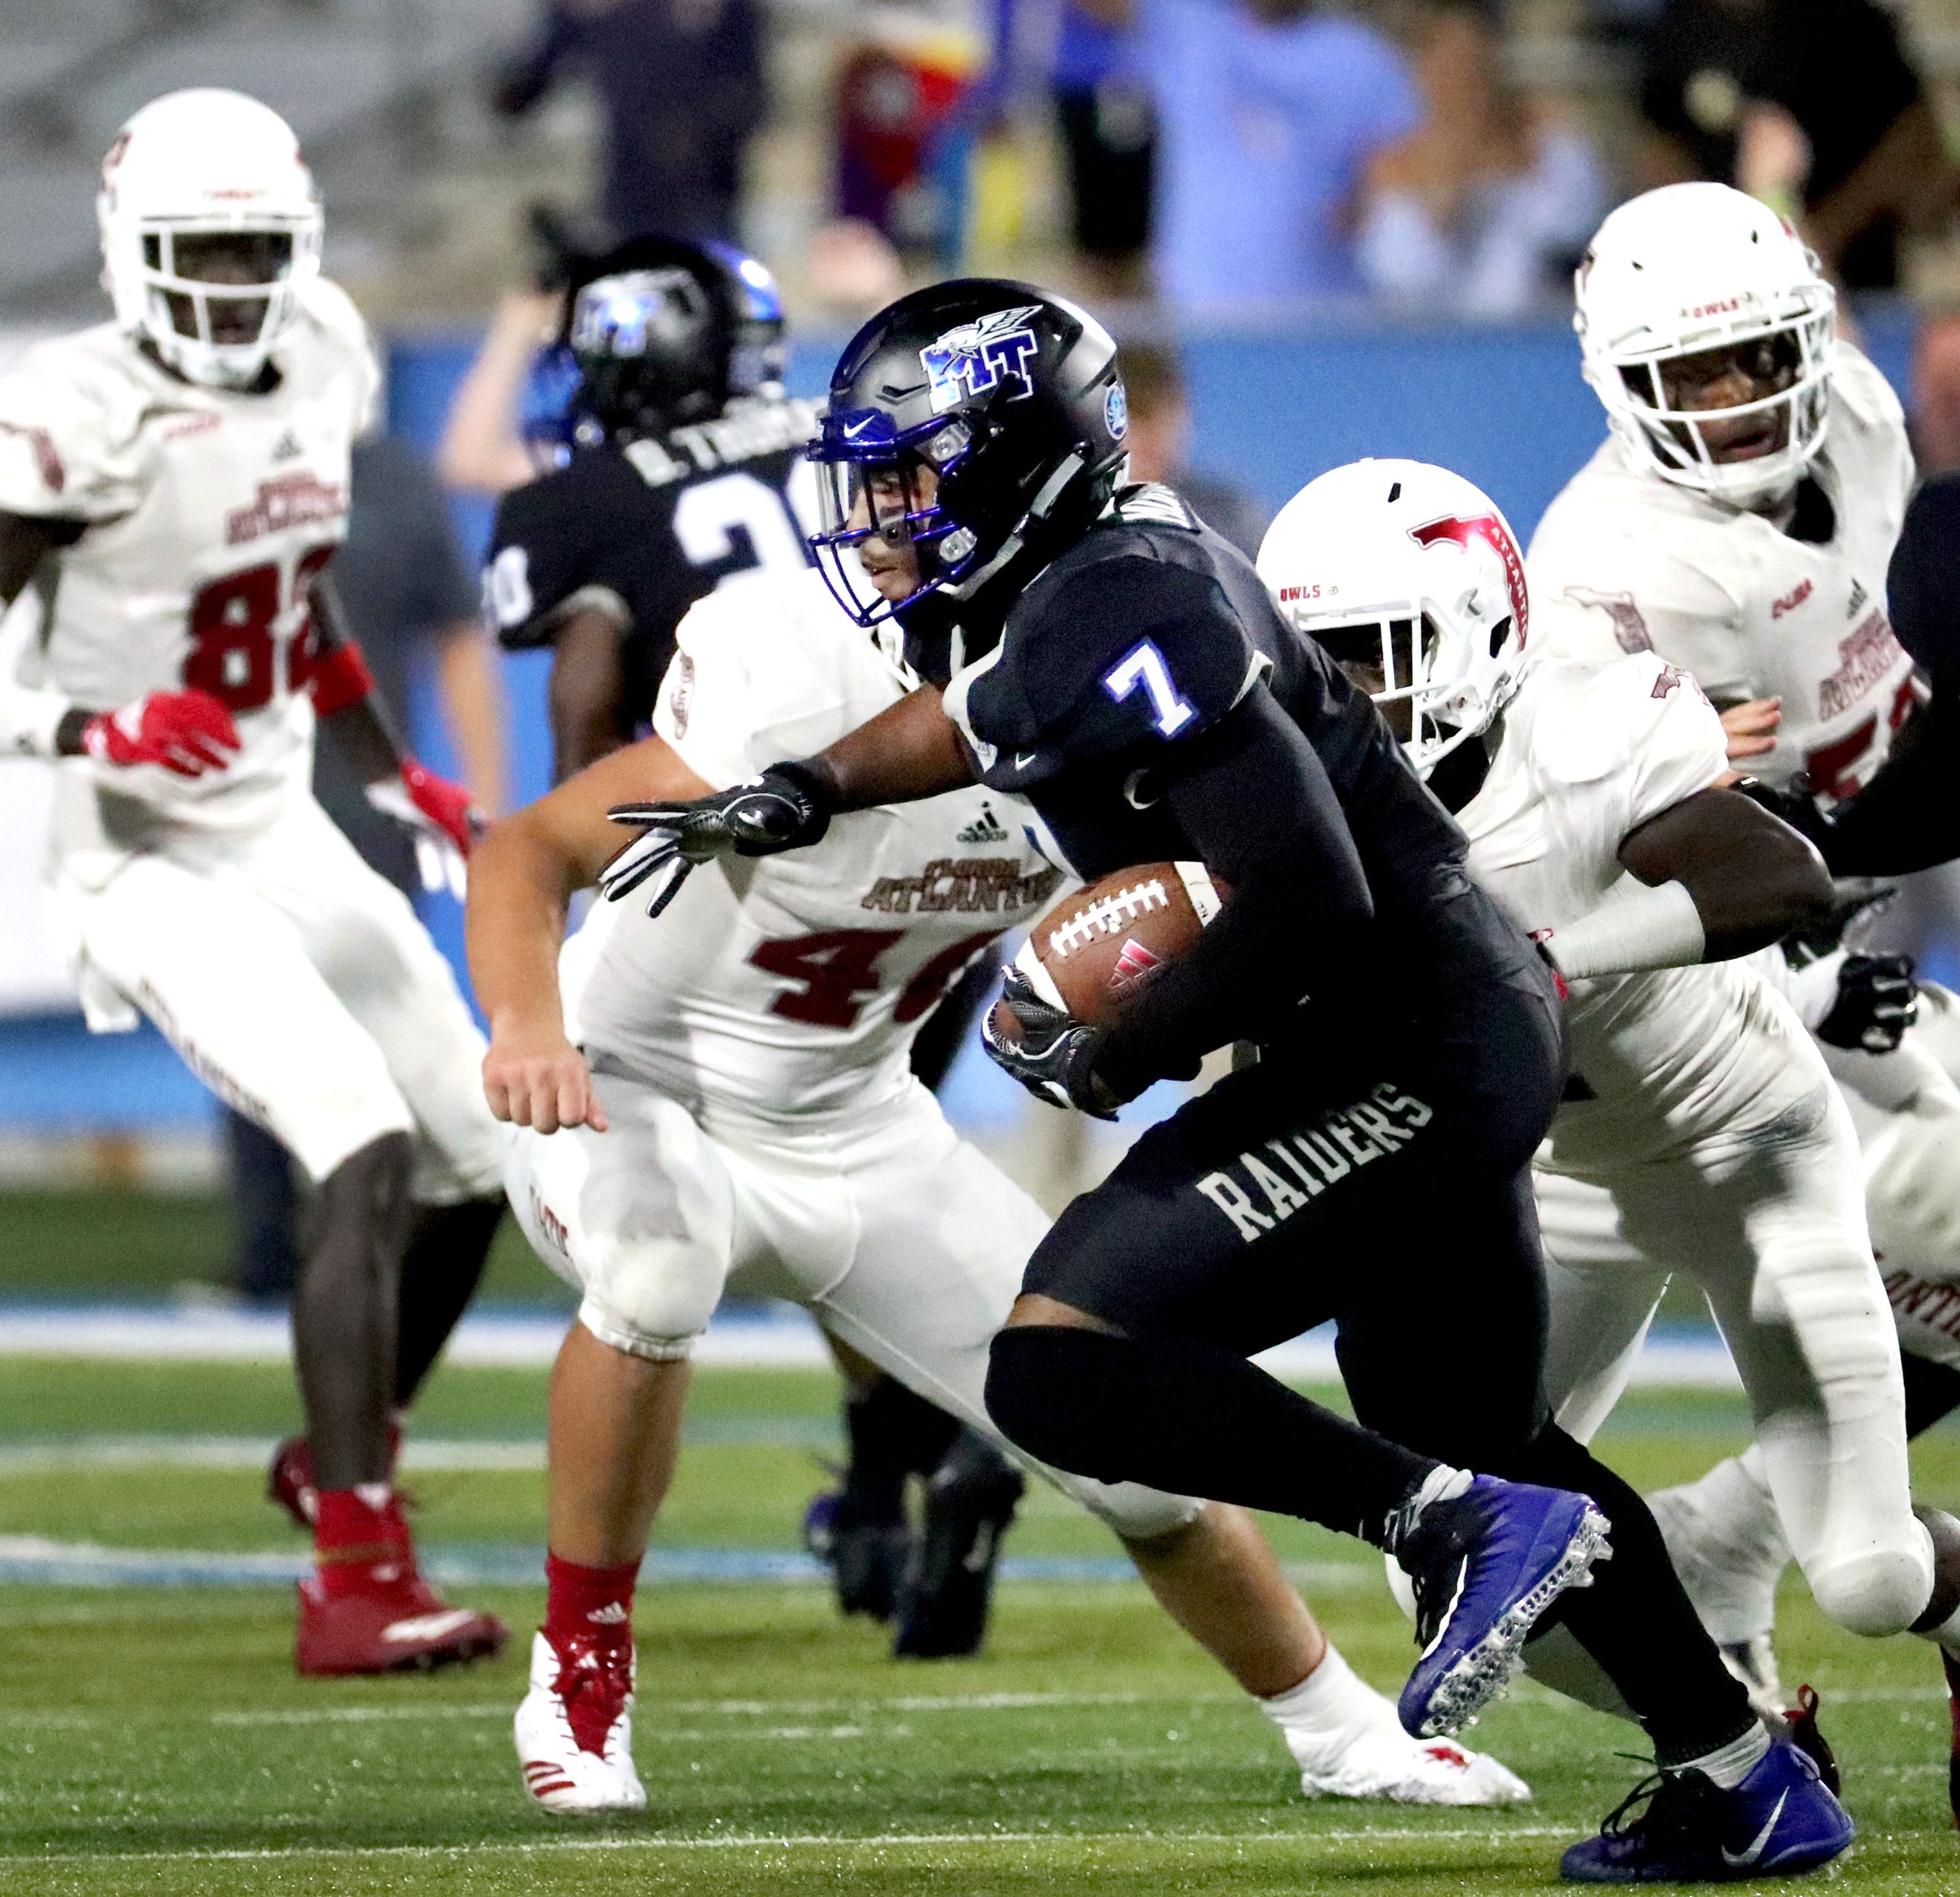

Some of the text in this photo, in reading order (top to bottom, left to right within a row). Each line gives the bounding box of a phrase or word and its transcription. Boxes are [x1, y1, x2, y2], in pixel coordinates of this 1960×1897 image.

[919, 328, 1039, 415] MT
[1279, 584, 1321, 602] OWLS
[1099, 636, 1200, 741] 7
[1194, 1082, 1433, 1243] RAIDERS
